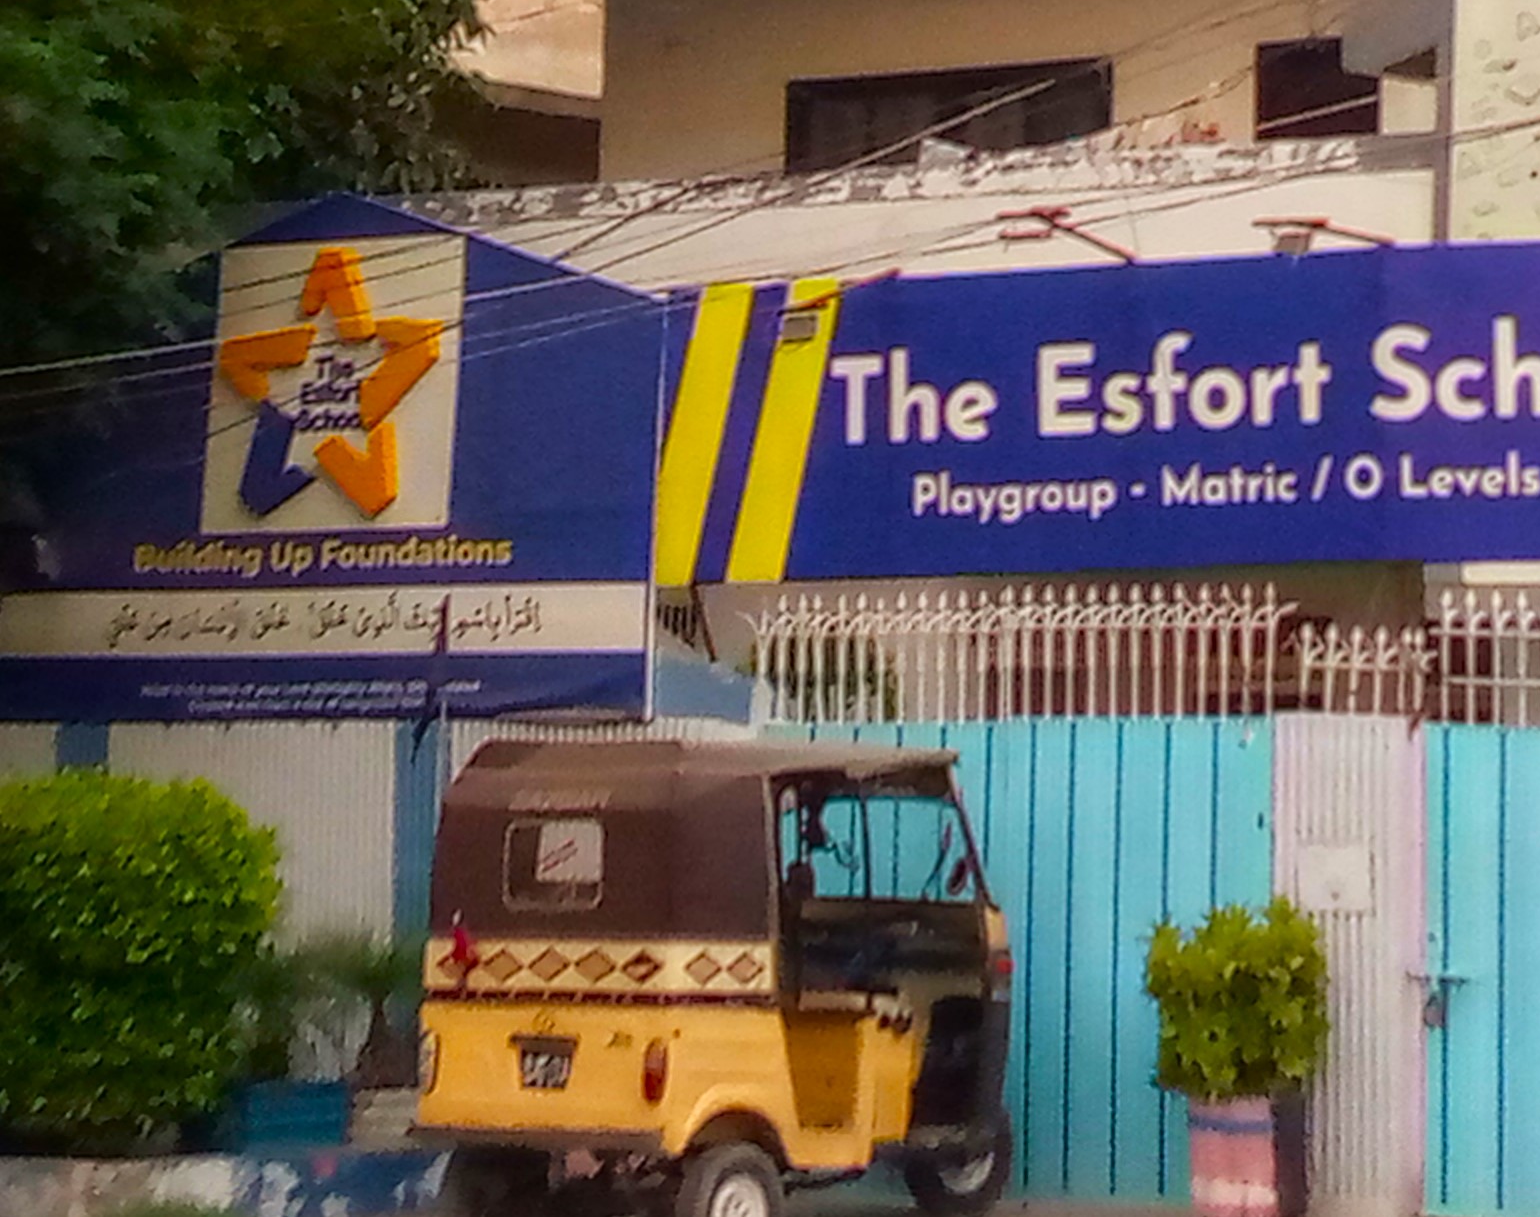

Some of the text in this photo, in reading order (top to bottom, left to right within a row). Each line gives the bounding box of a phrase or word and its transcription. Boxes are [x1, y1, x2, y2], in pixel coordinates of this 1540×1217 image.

[829, 344, 999, 447] The
[1036, 329, 1333, 439] Esfort
[911, 467, 1119, 526] Playgroup
[1159, 461, 1299, 507] Matric
[1344, 452, 1384, 501] O
[134, 533, 514, 579] Building Up Foundations
